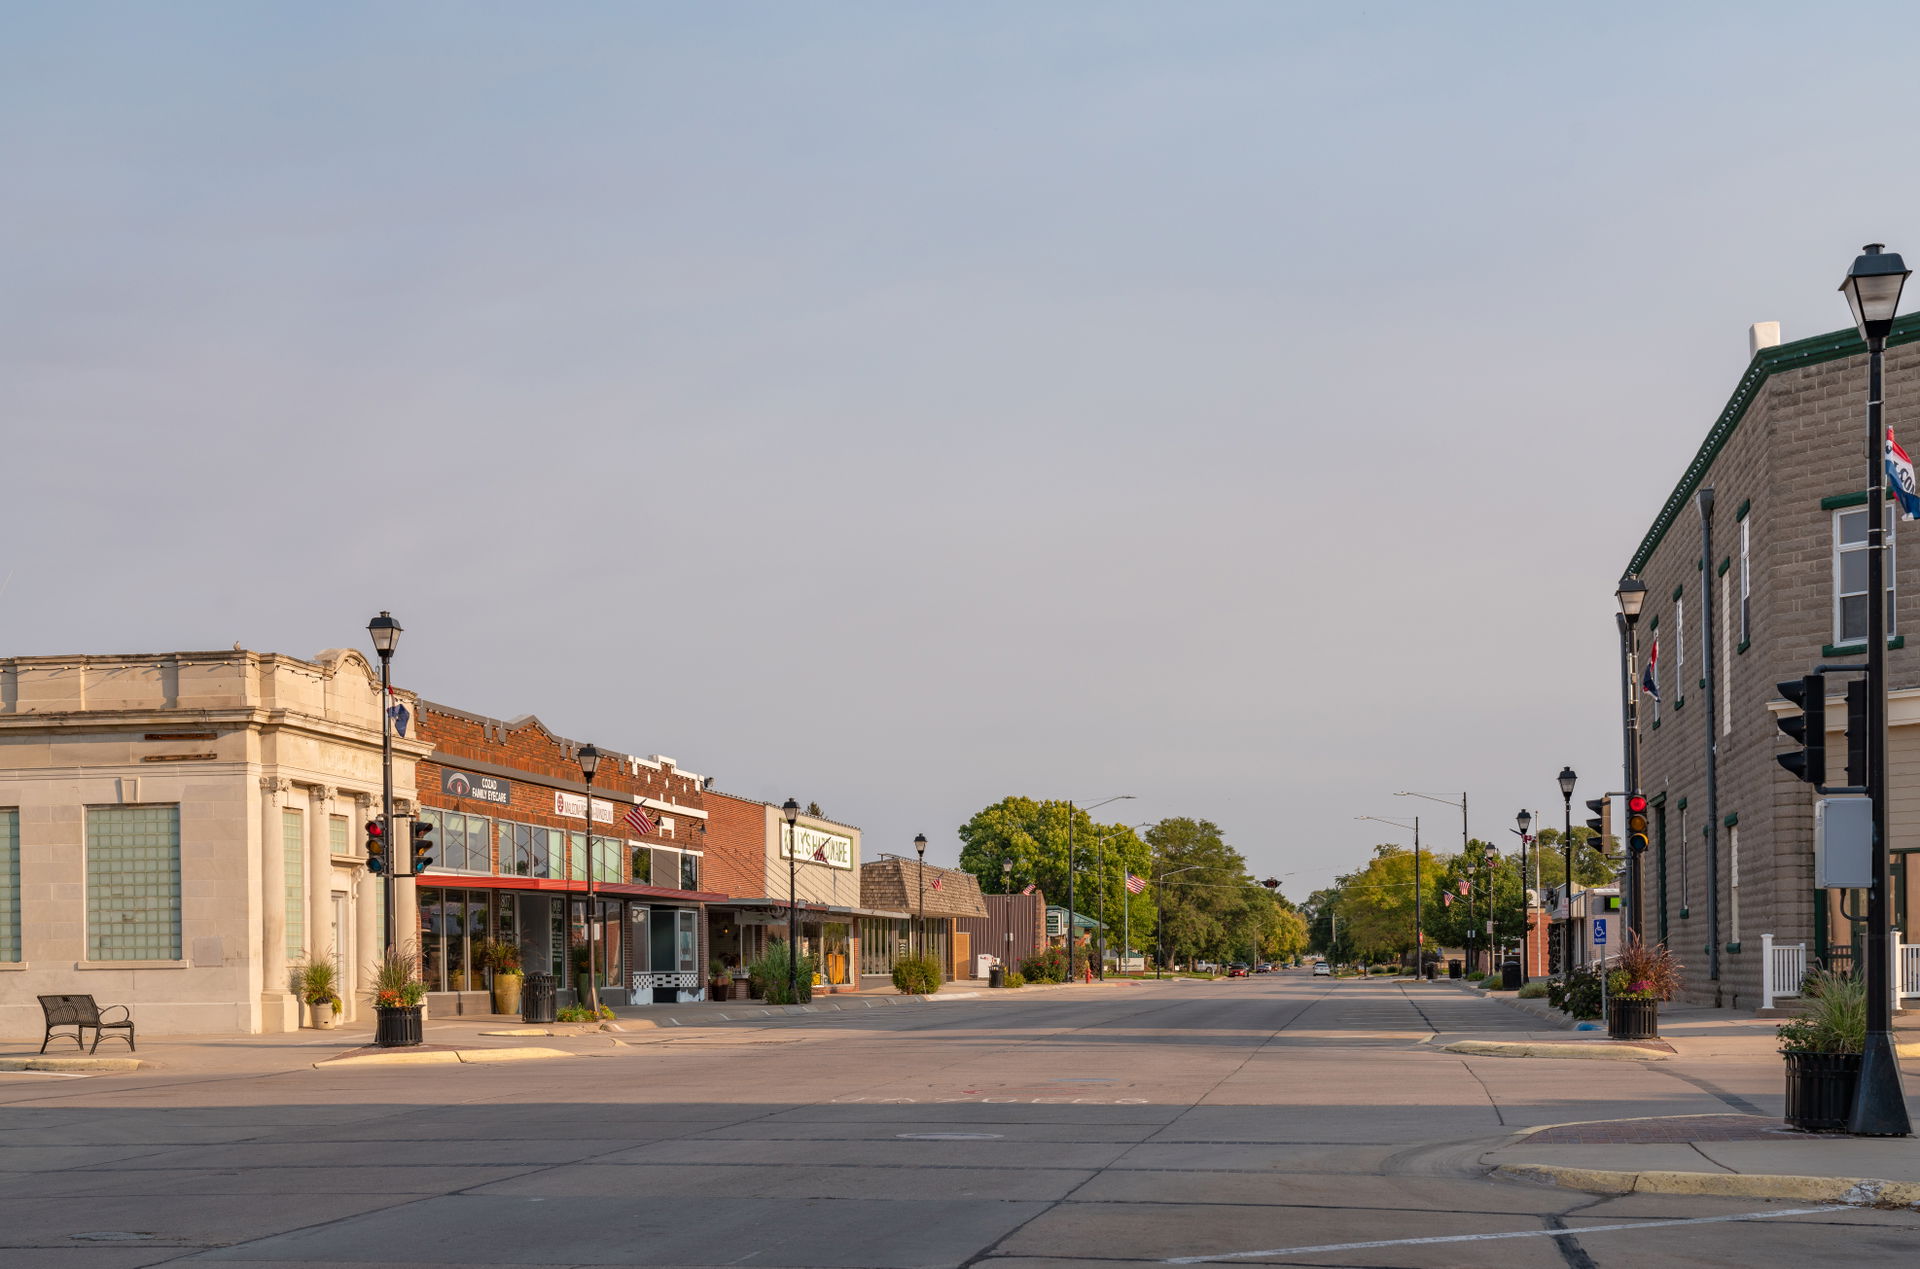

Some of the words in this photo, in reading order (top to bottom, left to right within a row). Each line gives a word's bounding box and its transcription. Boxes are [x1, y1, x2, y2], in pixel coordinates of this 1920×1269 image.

[482, 778, 497, 790] COZAD
[472, 787, 487, 800] FAMILY
[488, 790, 507, 803] EYECARE
[784, 828, 811, 856] KLLY'S
